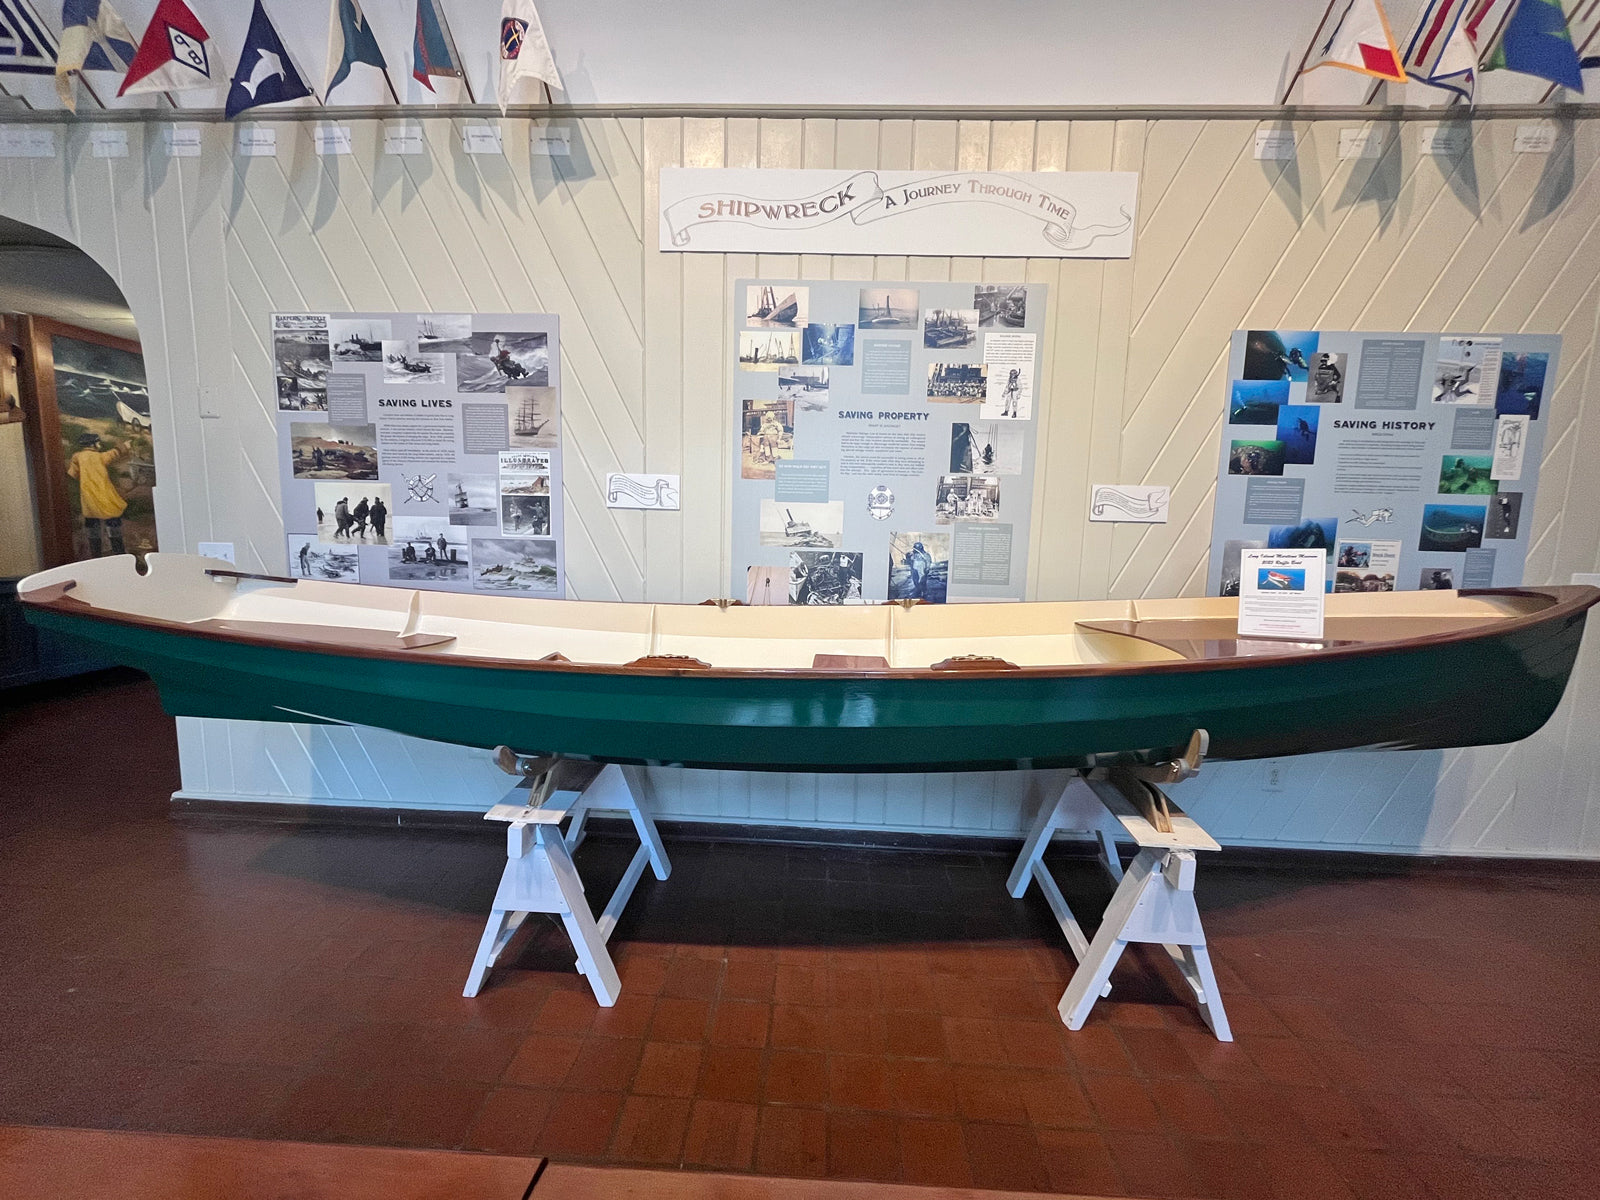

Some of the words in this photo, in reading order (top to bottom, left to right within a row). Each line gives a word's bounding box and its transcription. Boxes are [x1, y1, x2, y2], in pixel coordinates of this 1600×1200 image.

[697, 182, 857, 221] SHIPWRECK
[884, 195, 898, 210] A
[378, 399, 417, 408] SAVING
[421, 399, 453, 408] LIVES
[838, 410, 874, 420] SAVING
[878, 411, 930, 421] PROPERTY
[1333, 420, 1377, 430] SAVING
[1382, 421, 1436, 431] HISTORY
